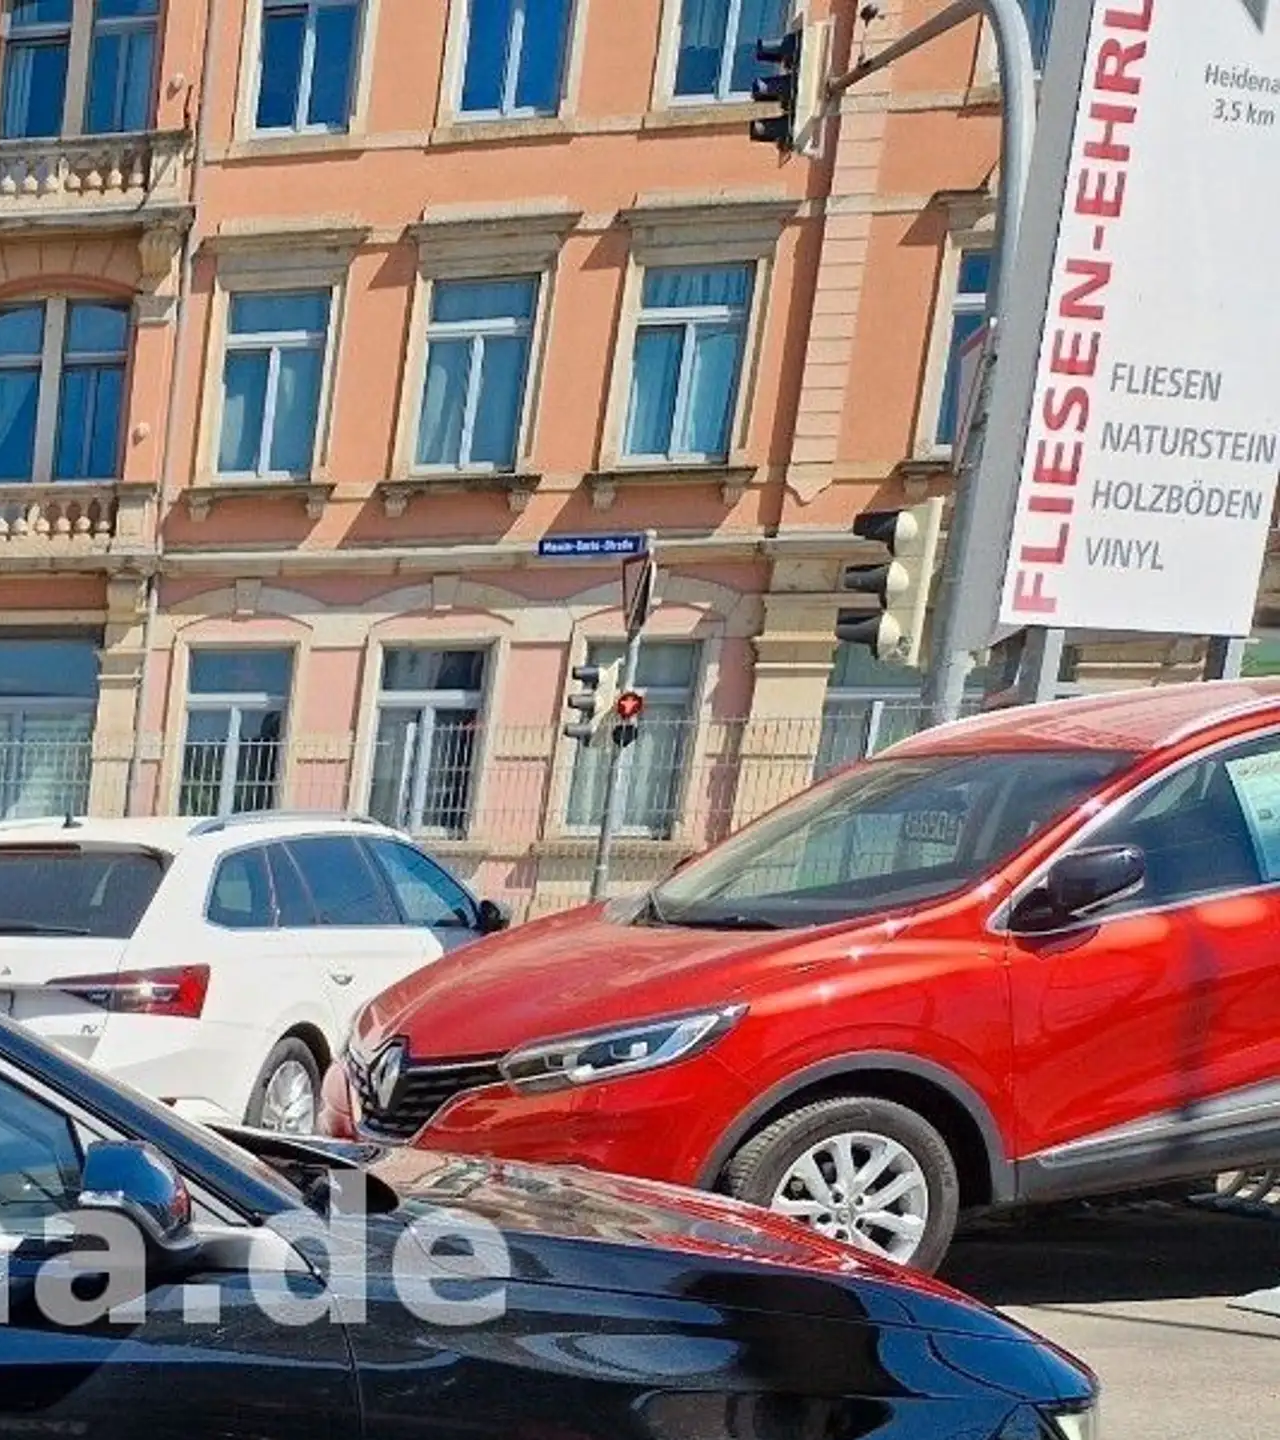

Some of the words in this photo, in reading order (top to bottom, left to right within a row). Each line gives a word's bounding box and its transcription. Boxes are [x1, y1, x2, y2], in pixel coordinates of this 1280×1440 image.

[1212, 98, 1241, 123] 3,5
[1246, 102, 1276, 126] km
[1109, 362, 1223, 402] FLIESEN
[1100, 421, 1277, 464] NATURSTEIN
[1090, 479, 1263, 521] HOLZBÖDEN
[1085, 536, 1165, 572] VINYL
